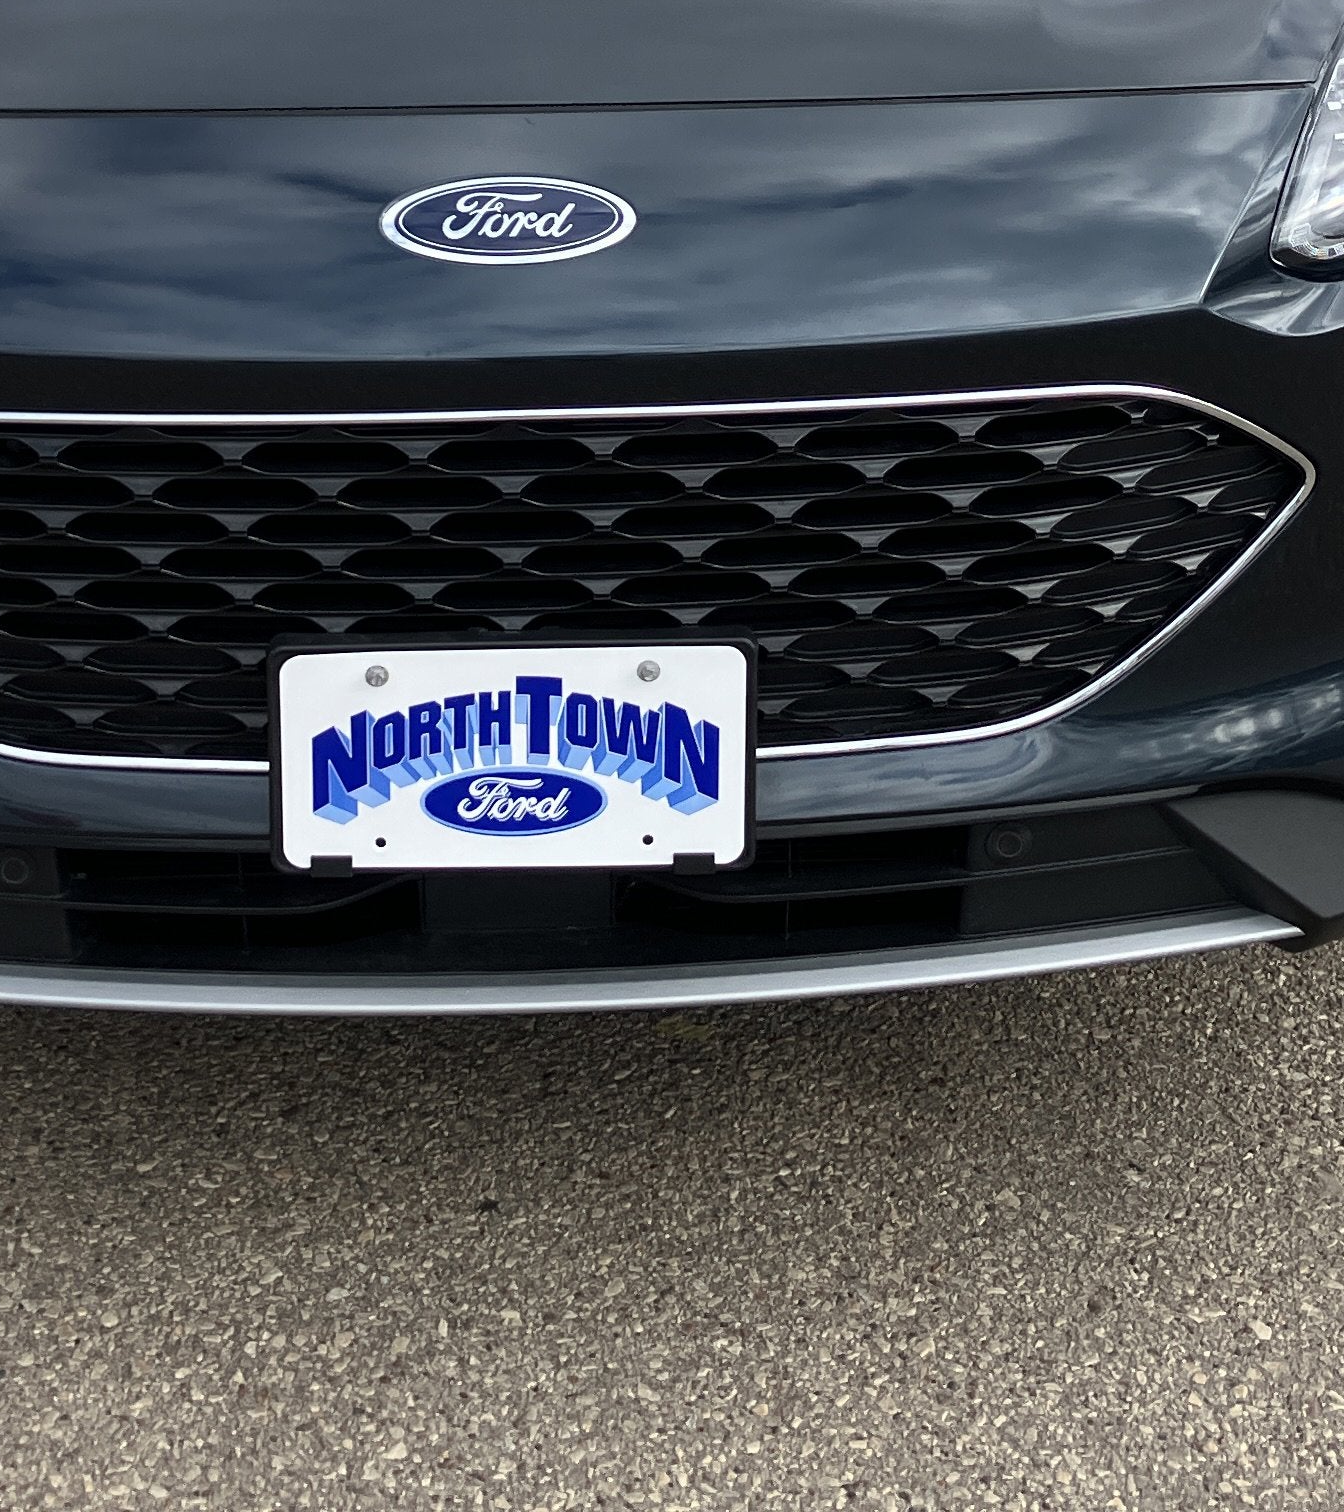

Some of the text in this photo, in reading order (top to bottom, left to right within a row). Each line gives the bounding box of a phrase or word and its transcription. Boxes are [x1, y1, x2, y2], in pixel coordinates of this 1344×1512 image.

[442, 192, 576, 239] Ford
[312, 675, 721, 822] NORTHTOWN
[457, 775, 569, 823] Ford
